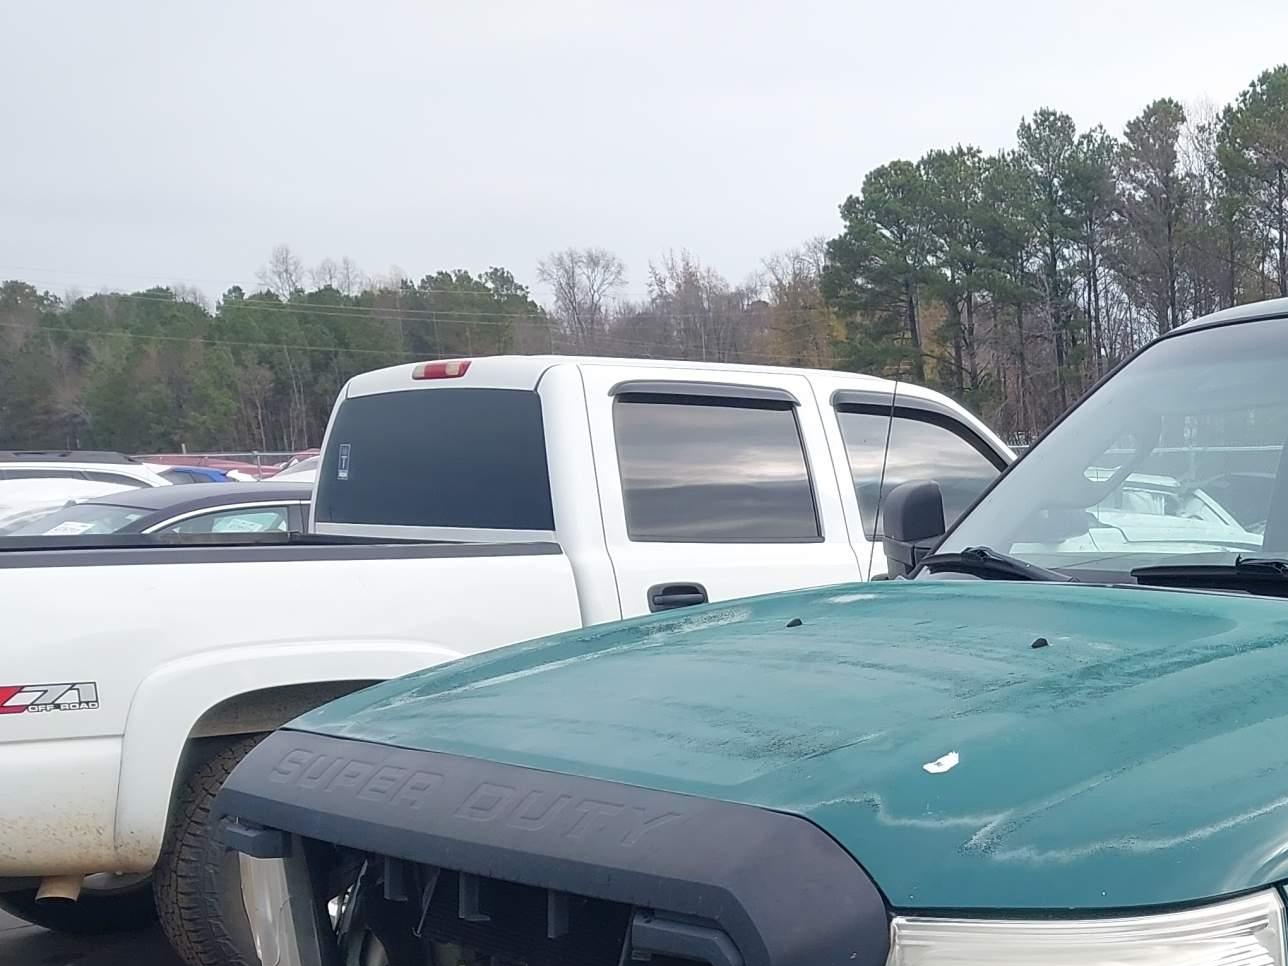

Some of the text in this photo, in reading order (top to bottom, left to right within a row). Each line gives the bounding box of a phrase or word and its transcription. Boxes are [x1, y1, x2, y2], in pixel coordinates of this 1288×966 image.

[28, 702, 98, 712] OFF ROAD
[269, 748, 685, 847] SUPER DUTY
